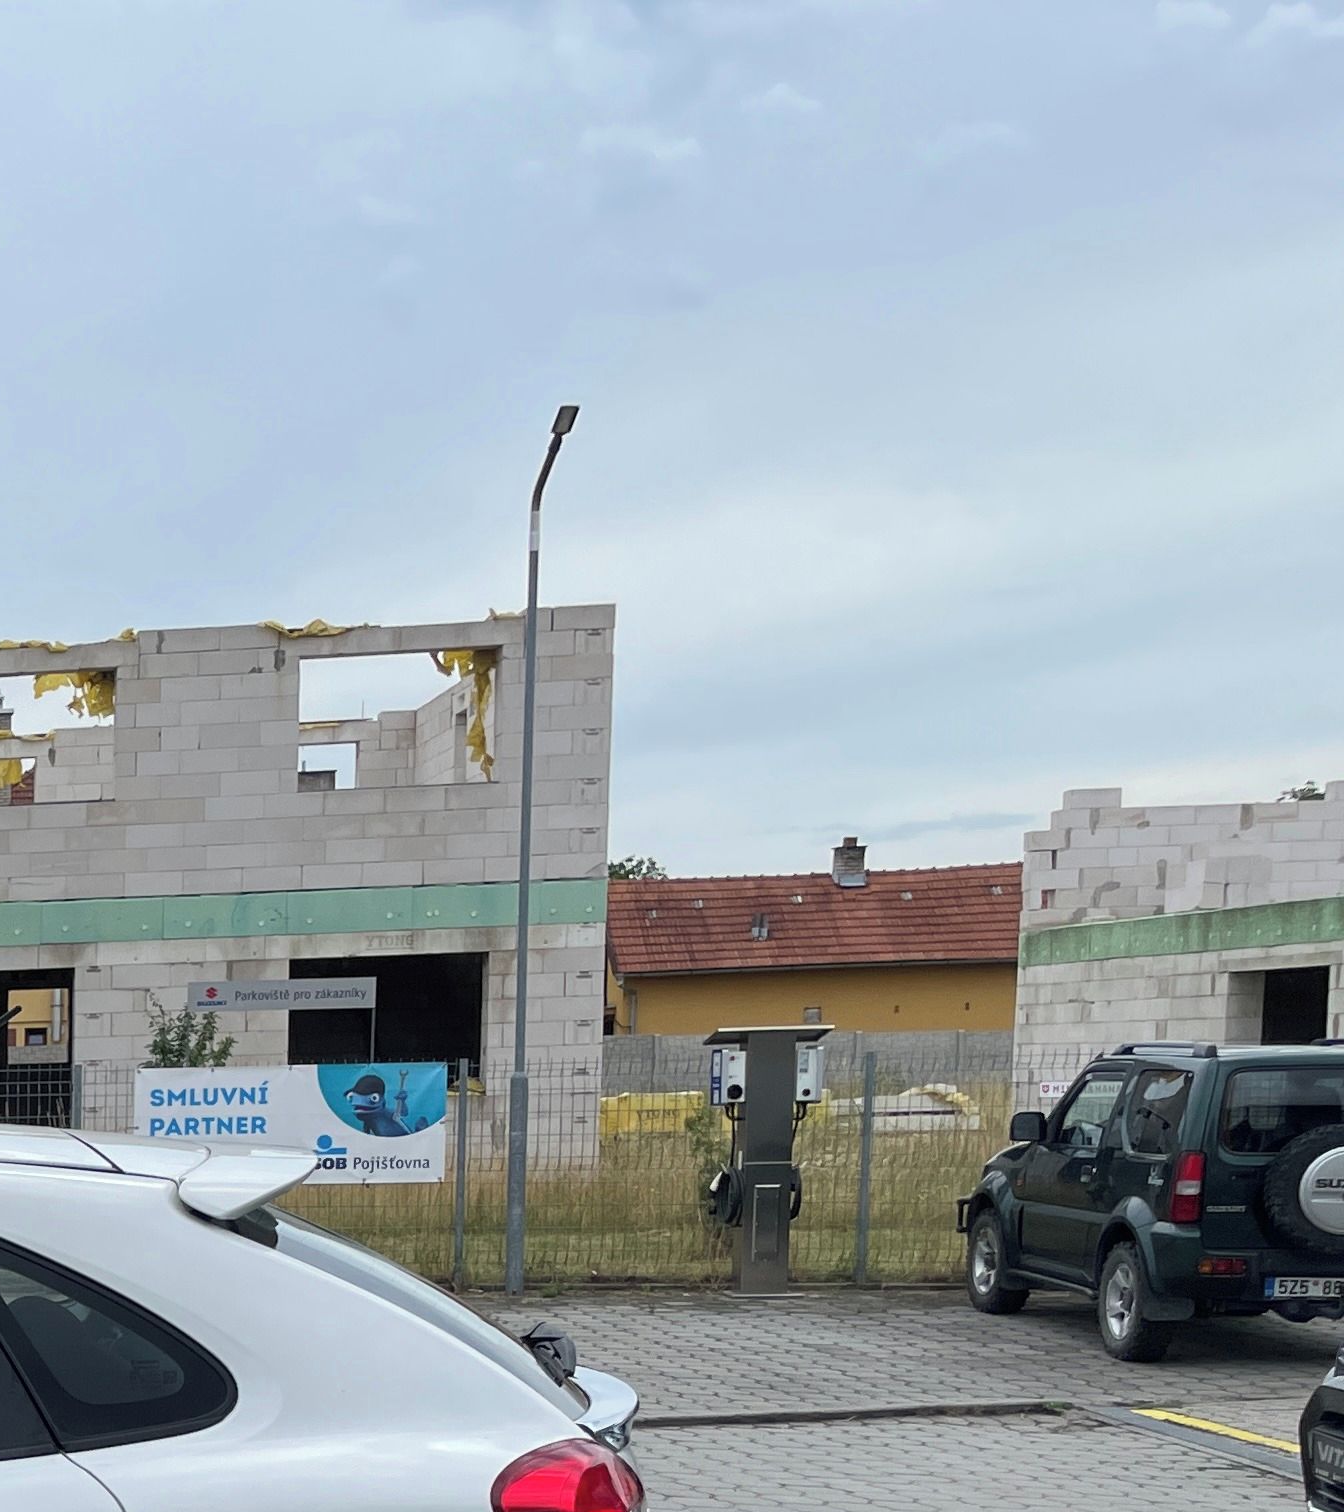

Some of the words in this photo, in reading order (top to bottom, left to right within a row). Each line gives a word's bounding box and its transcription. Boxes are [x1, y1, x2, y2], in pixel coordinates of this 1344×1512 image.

[234, 989, 290, 1001] Parkoviště
[293, 990, 311, 1001] pro
[315, 987, 367, 1000] zákazníky
[150, 1080, 269, 1107] SMLUVNÍ
[150, 1116, 267, 1137] PARTNER
[353, 1155, 430, 1174] Pojišťovna
[1278, 1279, 1309, 1295] 5Z5
